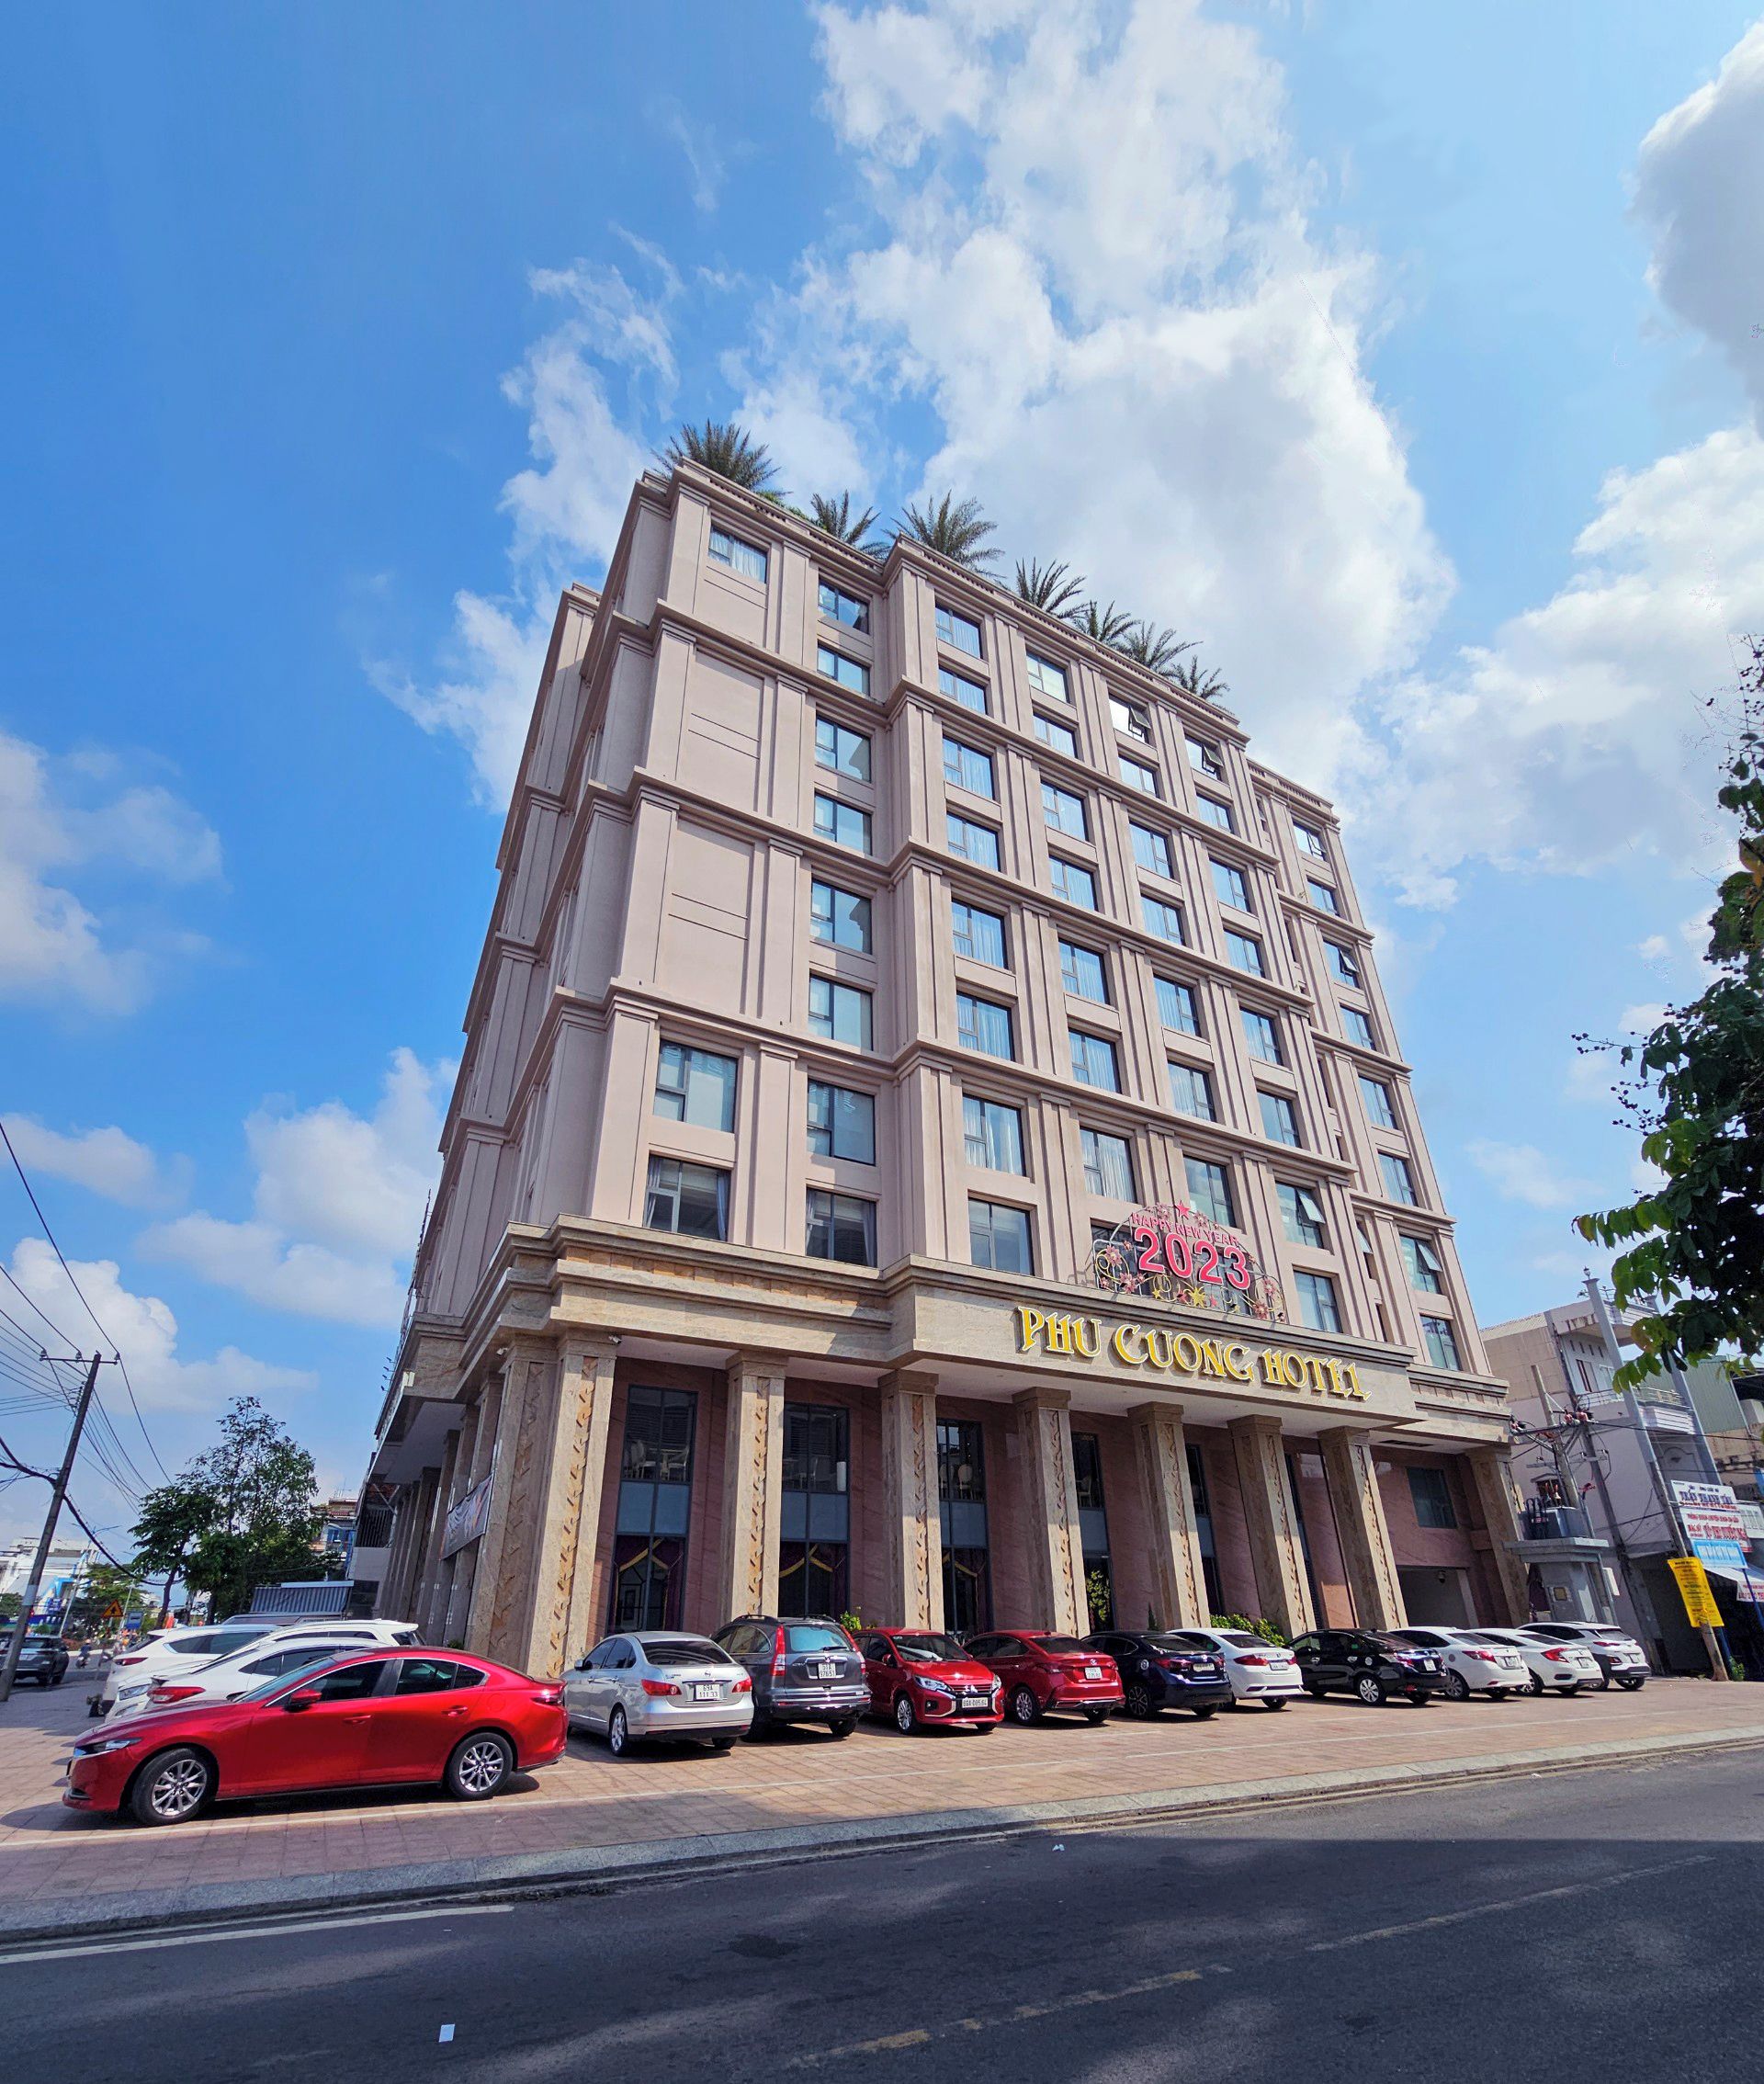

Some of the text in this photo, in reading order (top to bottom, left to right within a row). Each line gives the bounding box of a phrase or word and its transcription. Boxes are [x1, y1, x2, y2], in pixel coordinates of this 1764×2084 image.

[1131, 1213, 1240, 1248] HAPPY NEW YEAR
[1133, 1226, 1250, 1290] 2023
[1016, 1306, 1372, 1401] PHU CUONG HOTEL
